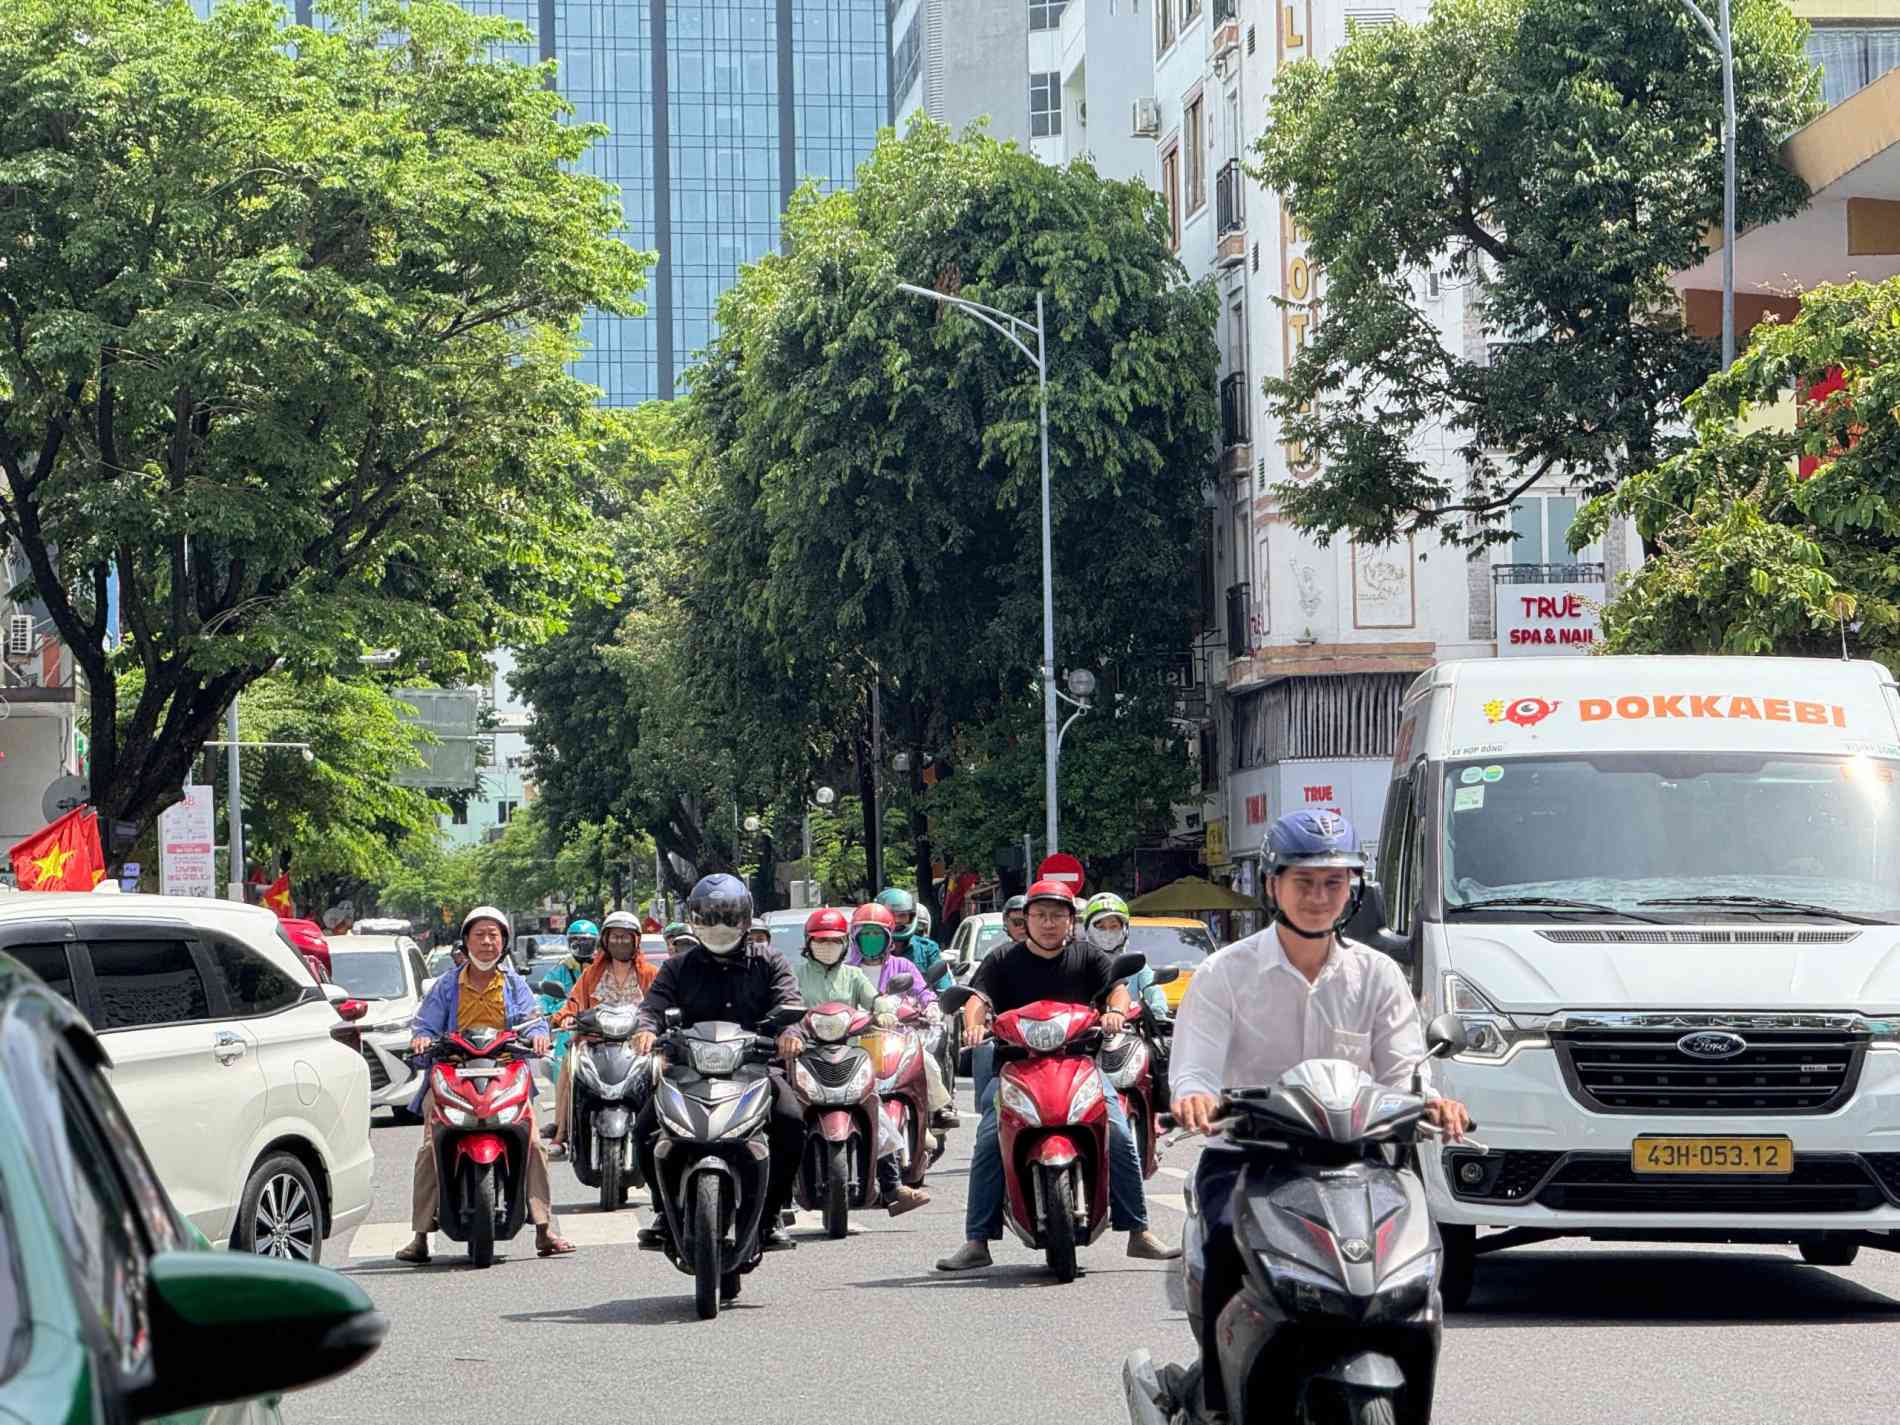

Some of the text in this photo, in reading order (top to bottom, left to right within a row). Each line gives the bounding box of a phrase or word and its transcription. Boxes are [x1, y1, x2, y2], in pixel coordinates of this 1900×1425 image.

[1520, 595, 1582, 619] TRUE
[1509, 628, 1542, 644] SPA
[1545, 627, 1557, 644] &
[1578, 694, 1848, 729] DOKKAEBI
[1304, 784, 1334, 802] TRUE
[1647, 1146, 1778, 1167] 43H-053.12
